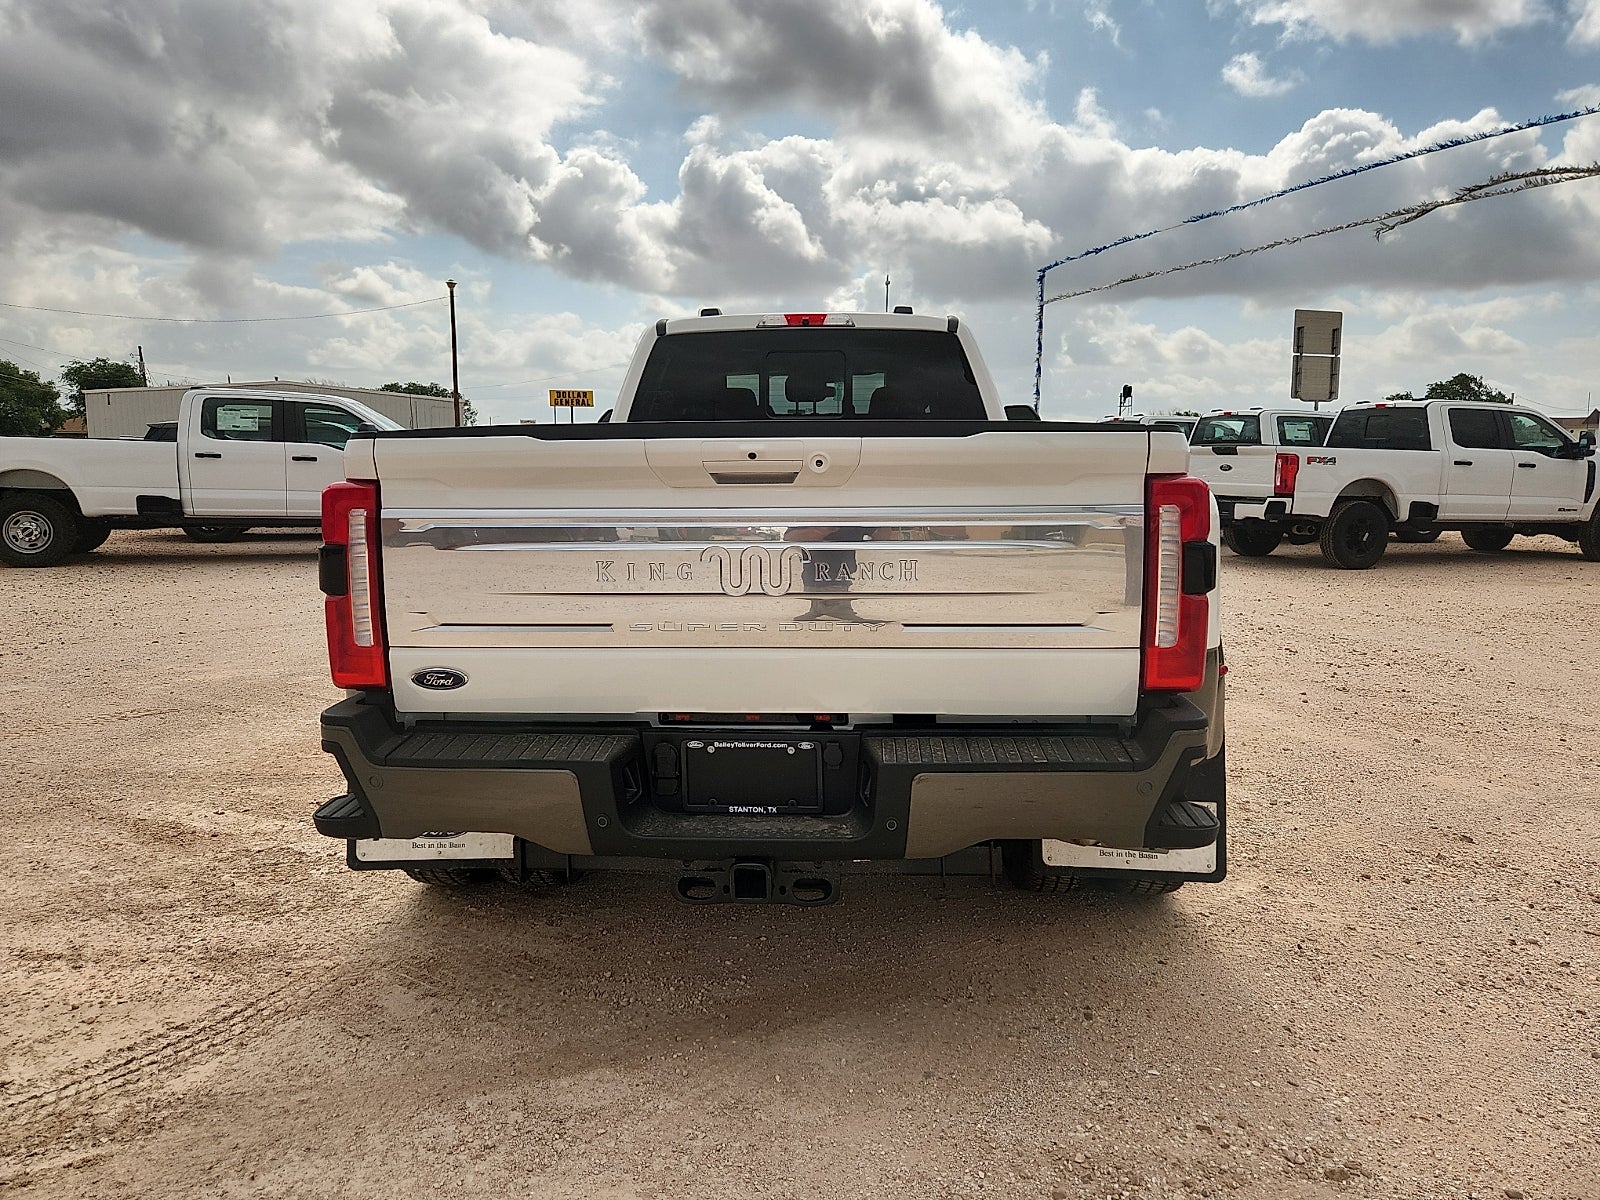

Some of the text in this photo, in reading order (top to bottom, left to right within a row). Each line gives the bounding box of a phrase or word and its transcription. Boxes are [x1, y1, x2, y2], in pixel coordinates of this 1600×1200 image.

[555, 391, 588, 399] DOLLAR
[554, 398, 591, 407] GENERAL
[1307, 456, 1337, 465] FX4
[595, 559, 919, 583] KING RANCH
[629, 621, 885, 632] SUPER DUTY
[423, 672, 455, 686] Ford
[728, 805, 778, 814] STANTON, TX
[411, 841, 427, 849] Best
[427, 841, 435, 849] in
[436, 841, 447, 849] the
[1099, 849, 1115, 857] Best
[1115, 850, 1123, 858] in
[1124, 850, 1137, 859] the
